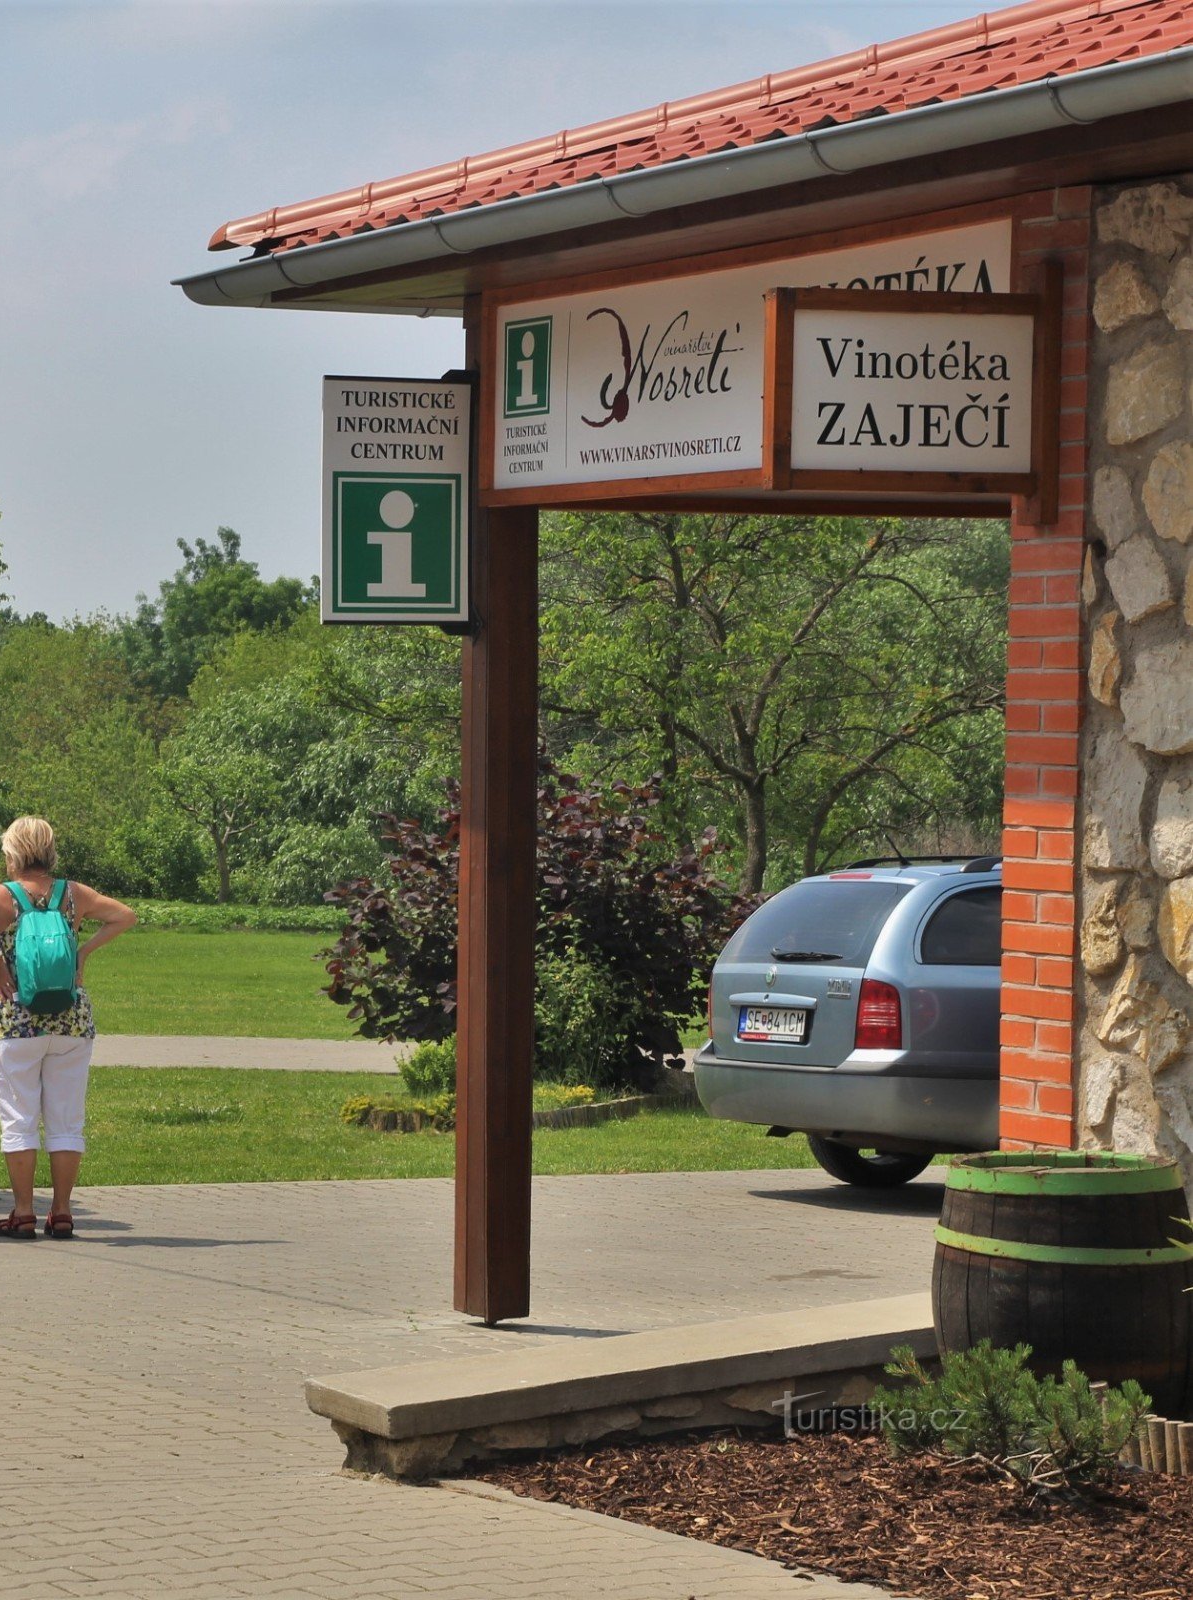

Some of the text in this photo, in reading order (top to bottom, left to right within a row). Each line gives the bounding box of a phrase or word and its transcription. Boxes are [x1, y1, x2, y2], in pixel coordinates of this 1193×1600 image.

[816, 337, 1010, 381] Vinotéka
[341, 390, 456, 410] TURISTICKÉ
[336, 415, 460, 436] INFORMAČNÍ
[506, 421, 547, 439] TURISTICKÉ
[816, 392, 1011, 448] ZAJEČÍ
[350, 442, 444, 461] CENTRUM
[503, 438, 549, 457] INFORMAČNÍ
[580, 435, 741, 465] WWW.VINARSTVINOSRETI.CZ
[508, 460, 543, 474] CENTRUM
